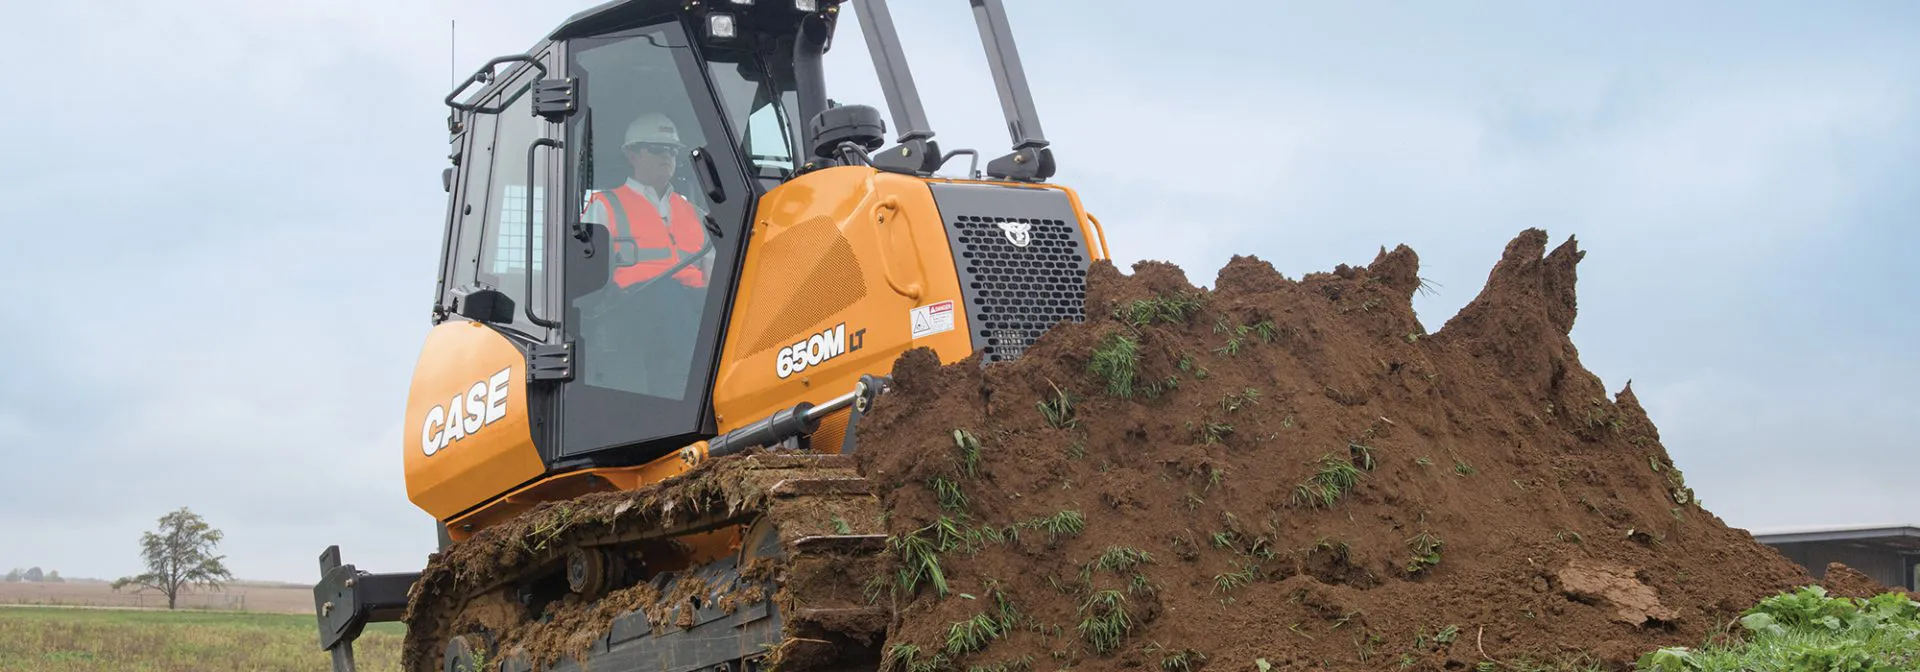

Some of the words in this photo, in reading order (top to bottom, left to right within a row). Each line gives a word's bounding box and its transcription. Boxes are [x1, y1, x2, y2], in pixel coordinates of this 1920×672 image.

[776, 321, 845, 379] 650M
[849, 328, 866, 352] LT
[421, 365, 511, 457] CASE
